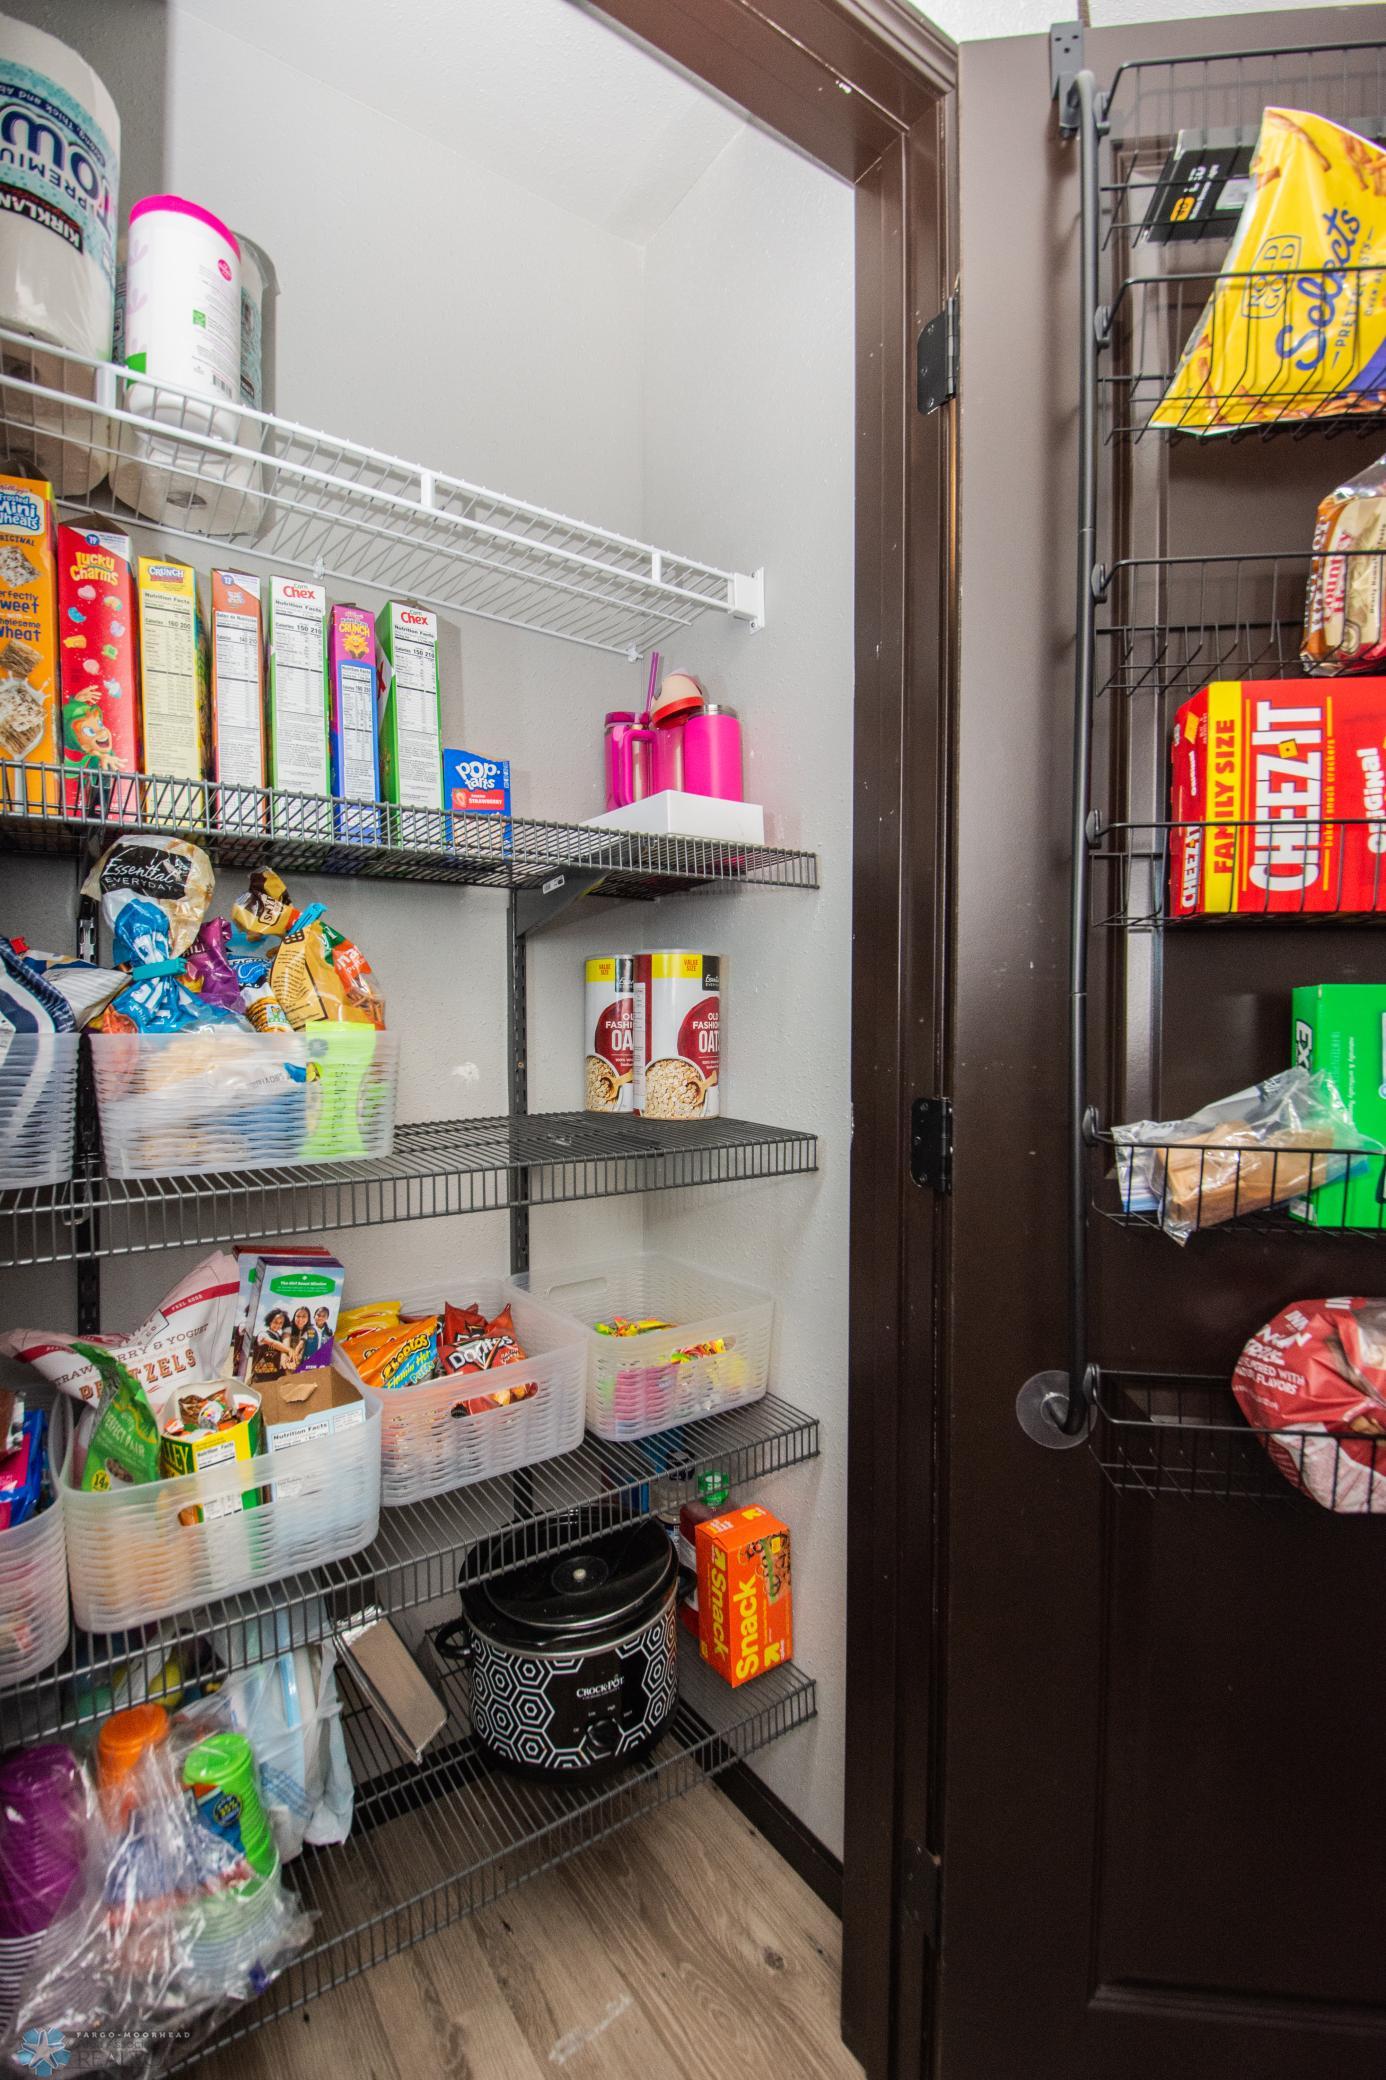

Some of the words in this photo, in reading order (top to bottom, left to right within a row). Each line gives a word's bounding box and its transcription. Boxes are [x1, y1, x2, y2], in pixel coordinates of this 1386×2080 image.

[1247, 243, 1279, 308] ROD
[1263, 243, 1298, 310] GOD
[1276, 207, 1361, 371] Selects
[0, 511, 40, 531] heats
[75, 551, 115, 571] Lucky
[148, 566, 184, 578] CRUNCH
[70, 564, 119, 586] Charms
[283, 585, 316, 600] Chex
[400, 611, 429, 626] Chex
[338, 622, 370, 638] CRUNCH
[1213, 718, 1235, 774] SIZE
[1213, 779, 1235, 874] FAMILY
[102, 857, 176, 883] Essential
[104, 876, 174, 891] EVERYDAY
[153, 1340, 163, 1350] &
[447, 1335, 516, 1370] Doritos
[273, 1428, 306, 1440] Nutrition
[308, 1422, 327, 1431] Facts
[711, 1566, 729, 1662] Snack
[733, 1573, 760, 1681] Snack
